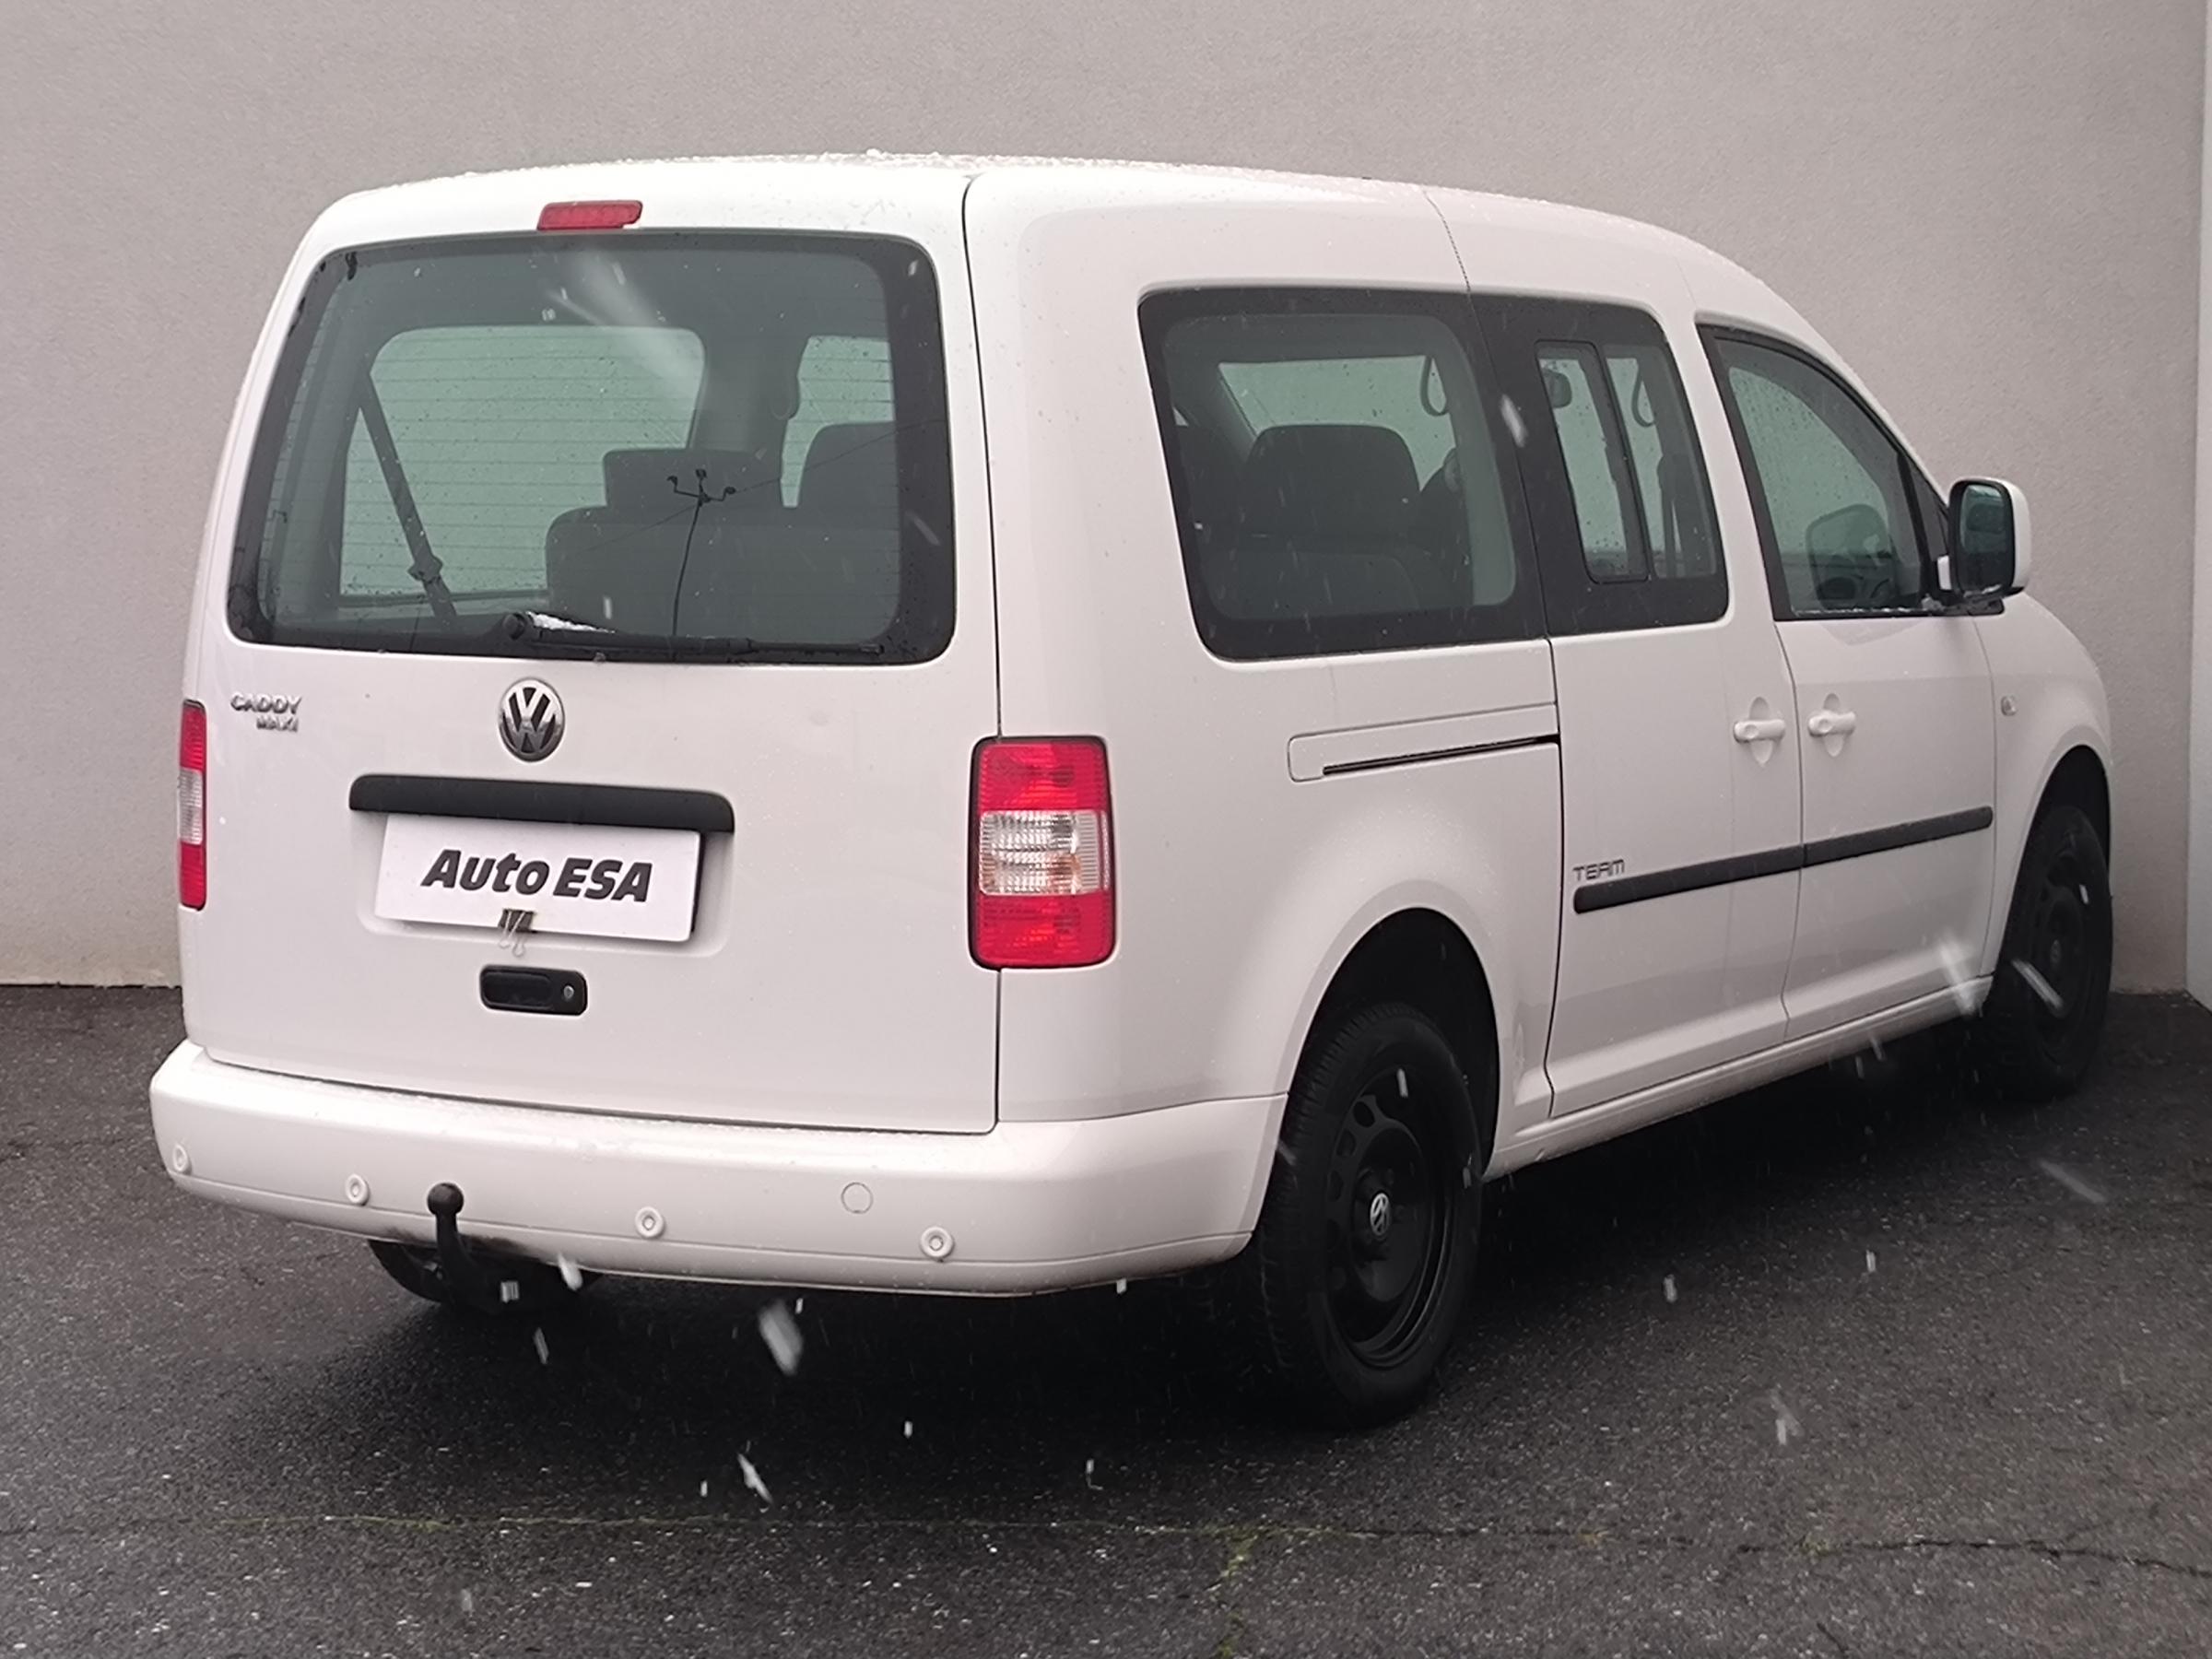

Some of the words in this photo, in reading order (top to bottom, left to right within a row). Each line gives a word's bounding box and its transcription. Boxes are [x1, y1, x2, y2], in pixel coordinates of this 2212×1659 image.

[229, 692, 302, 714] CADDY
[420, 849, 550, 895] Auto
[553, 857, 653, 902] ESA
[1572, 859, 1625, 881] TEAM
